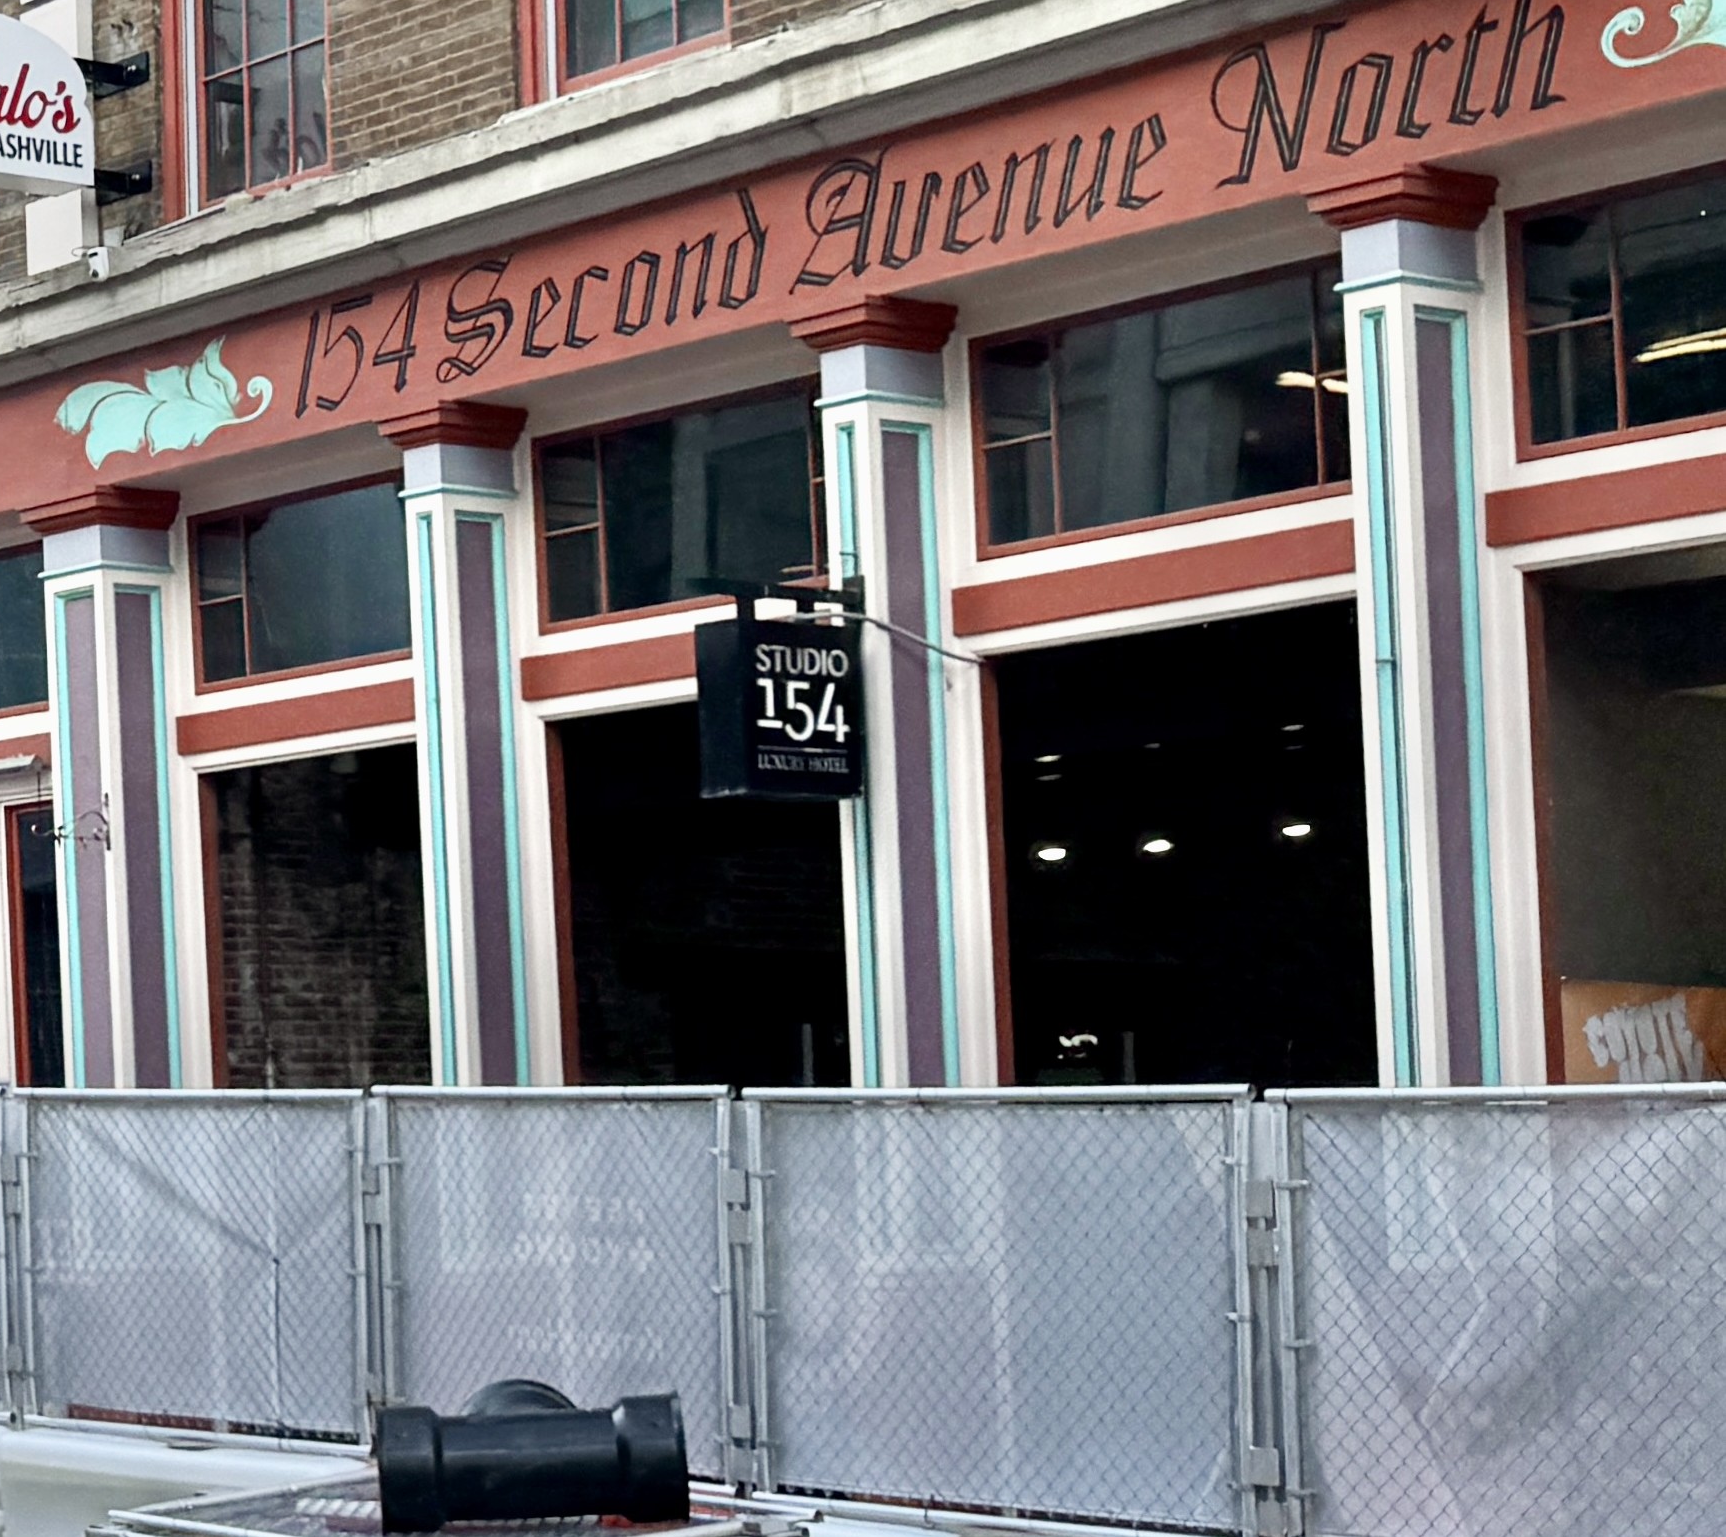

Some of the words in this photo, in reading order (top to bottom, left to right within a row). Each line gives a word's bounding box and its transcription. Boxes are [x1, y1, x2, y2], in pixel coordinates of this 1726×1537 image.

[294, 278, 421, 418] 154
[435, 187, 769, 384] Second
[788, 113, 1170, 295] Avenue
[755, 643, 849, 677] STUDIO
[756, 677, 851, 743] 154
[808, 755, 850, 774] HOTEL
